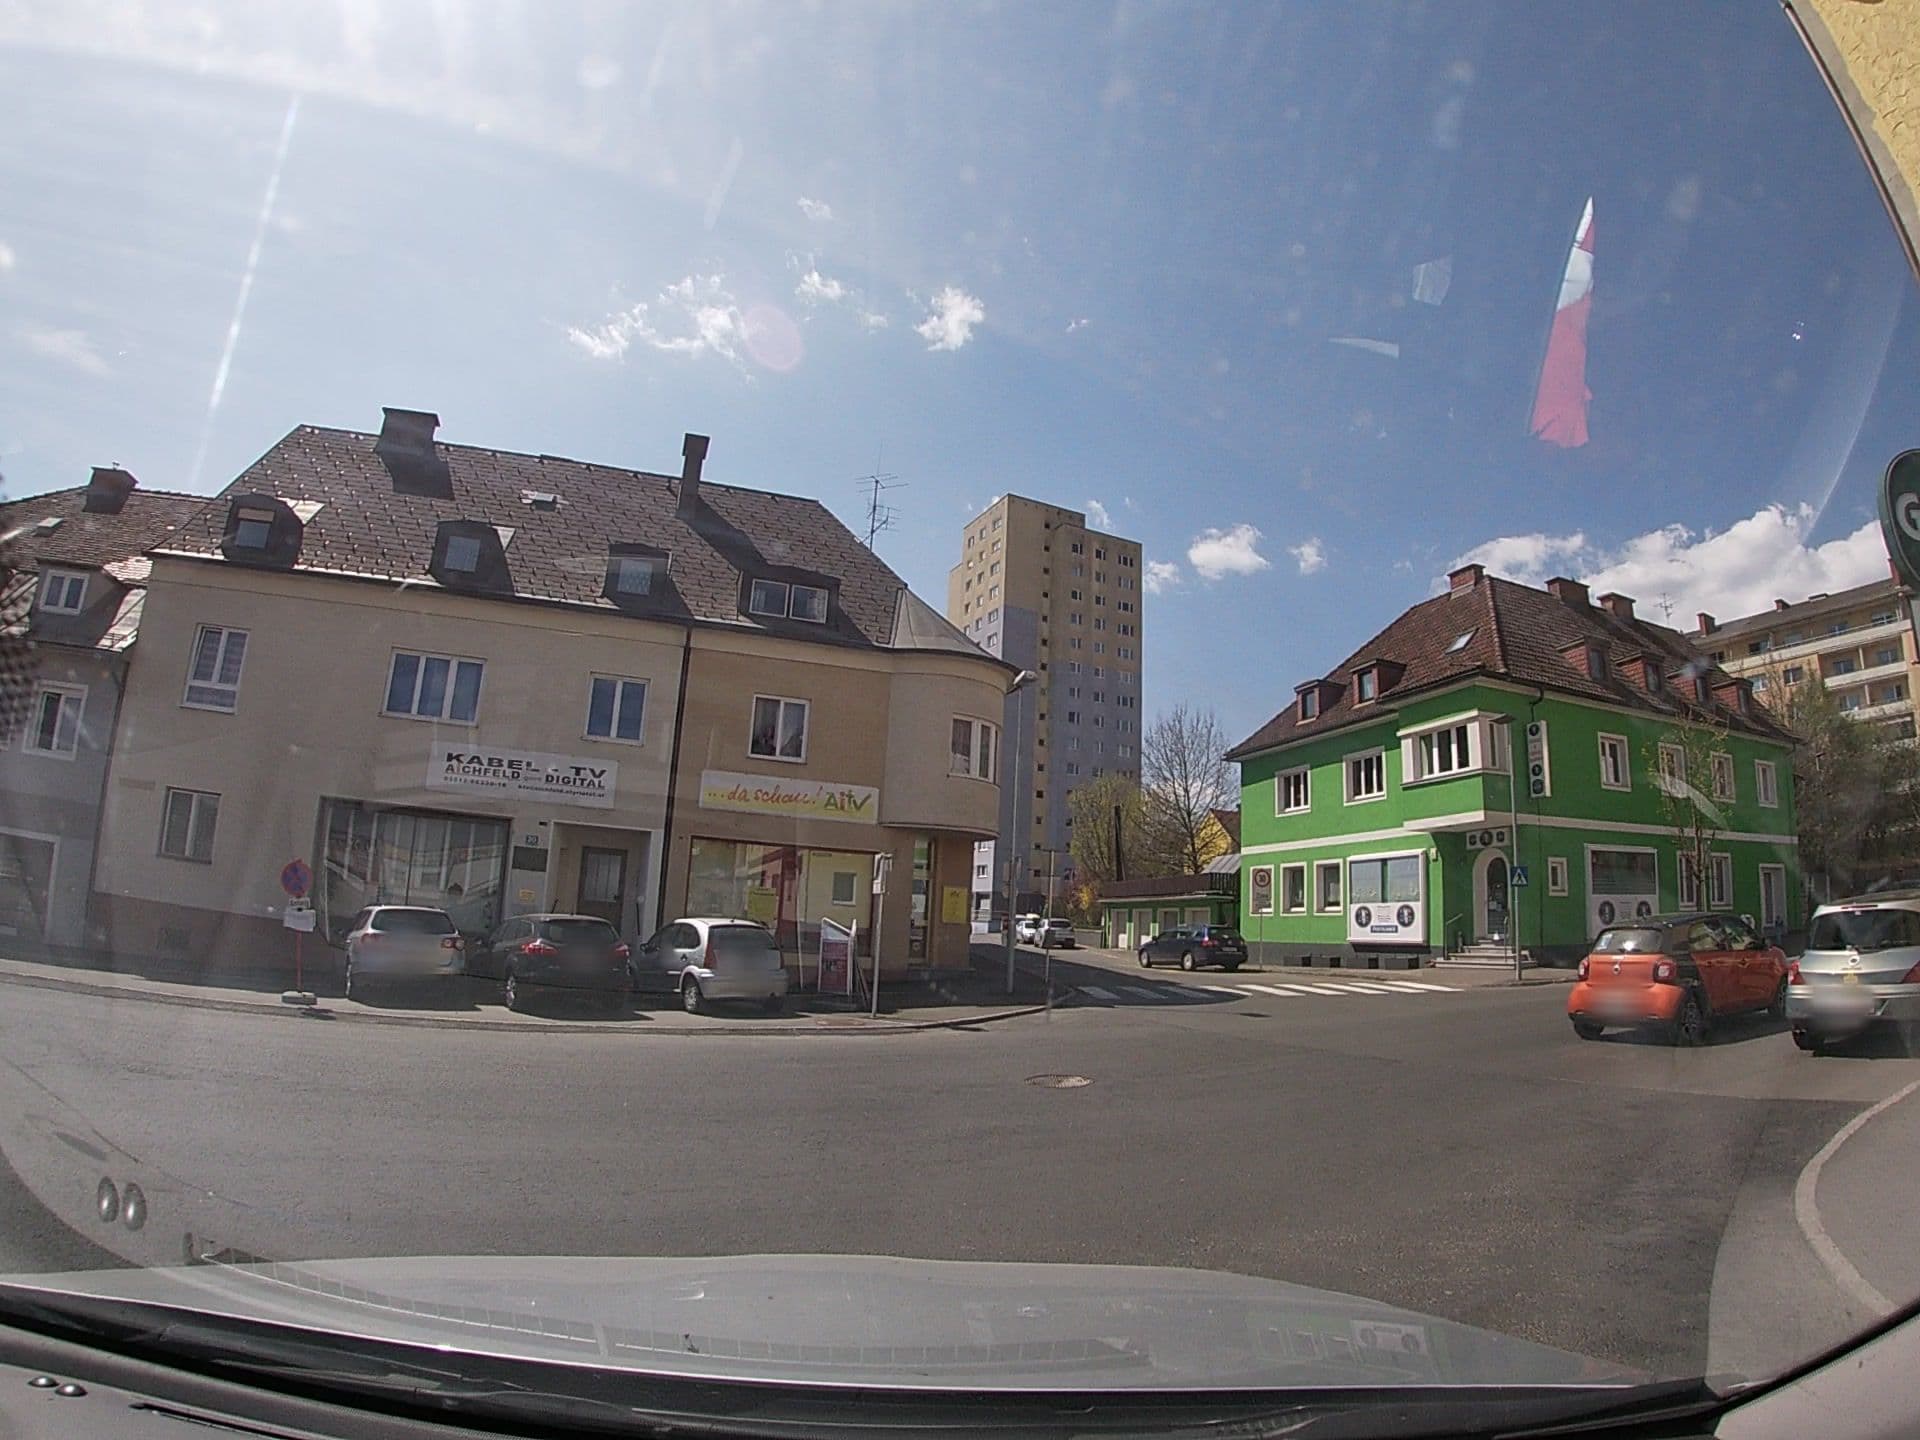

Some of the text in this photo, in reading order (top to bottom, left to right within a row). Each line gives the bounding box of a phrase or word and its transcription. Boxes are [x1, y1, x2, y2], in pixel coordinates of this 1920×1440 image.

[445, 764, 605, 789] AICHFELD DIGITAL
[446, 752, 540, 772] KABEL
[569, 765, 607, 779] TV
